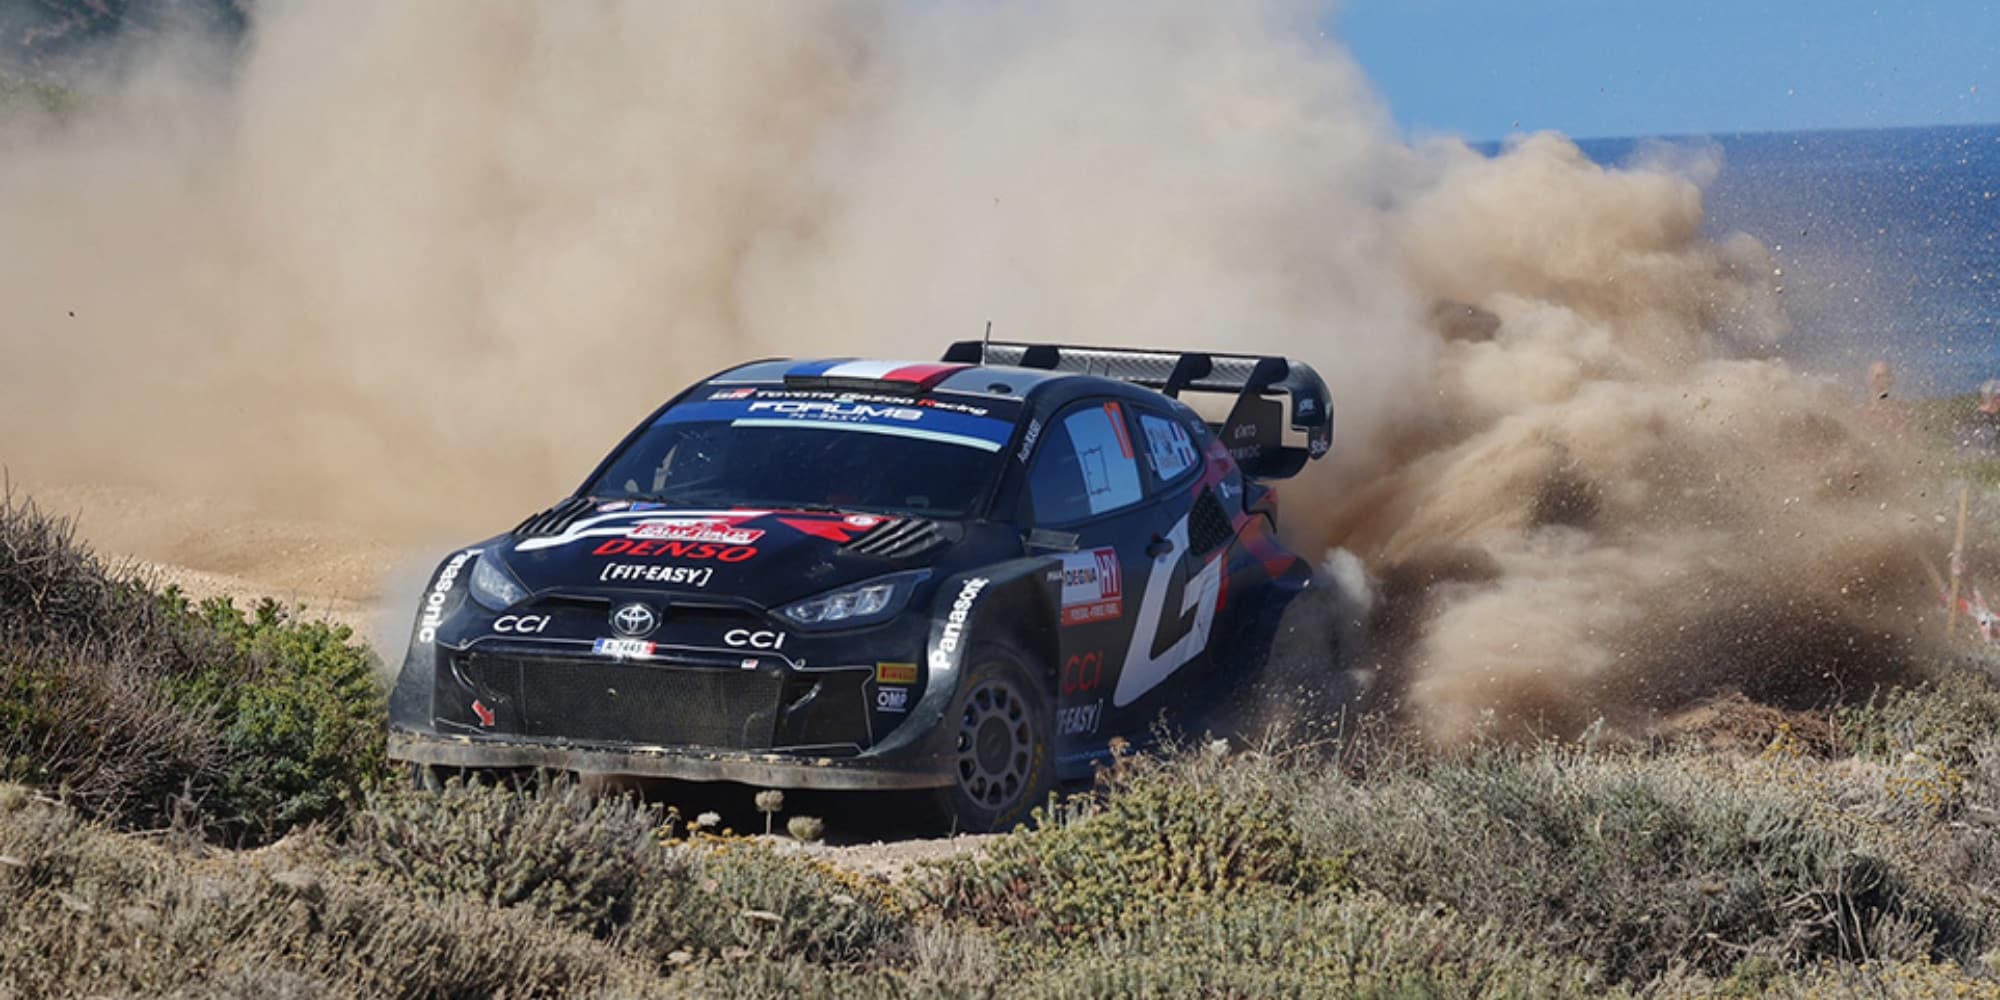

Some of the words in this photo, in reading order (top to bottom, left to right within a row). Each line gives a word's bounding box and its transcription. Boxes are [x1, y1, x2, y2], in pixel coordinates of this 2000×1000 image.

[757, 389, 837, 400] TOYOTA
[917, 396, 988, 416] Racing
[592, 539, 758, 562] DENSO
[600, 562, 713, 587] [FIT-EASY]
[493, 615, 551, 633] CCI
[724, 629, 786, 649] CCI
[1063, 650, 1103, 695] CCI
